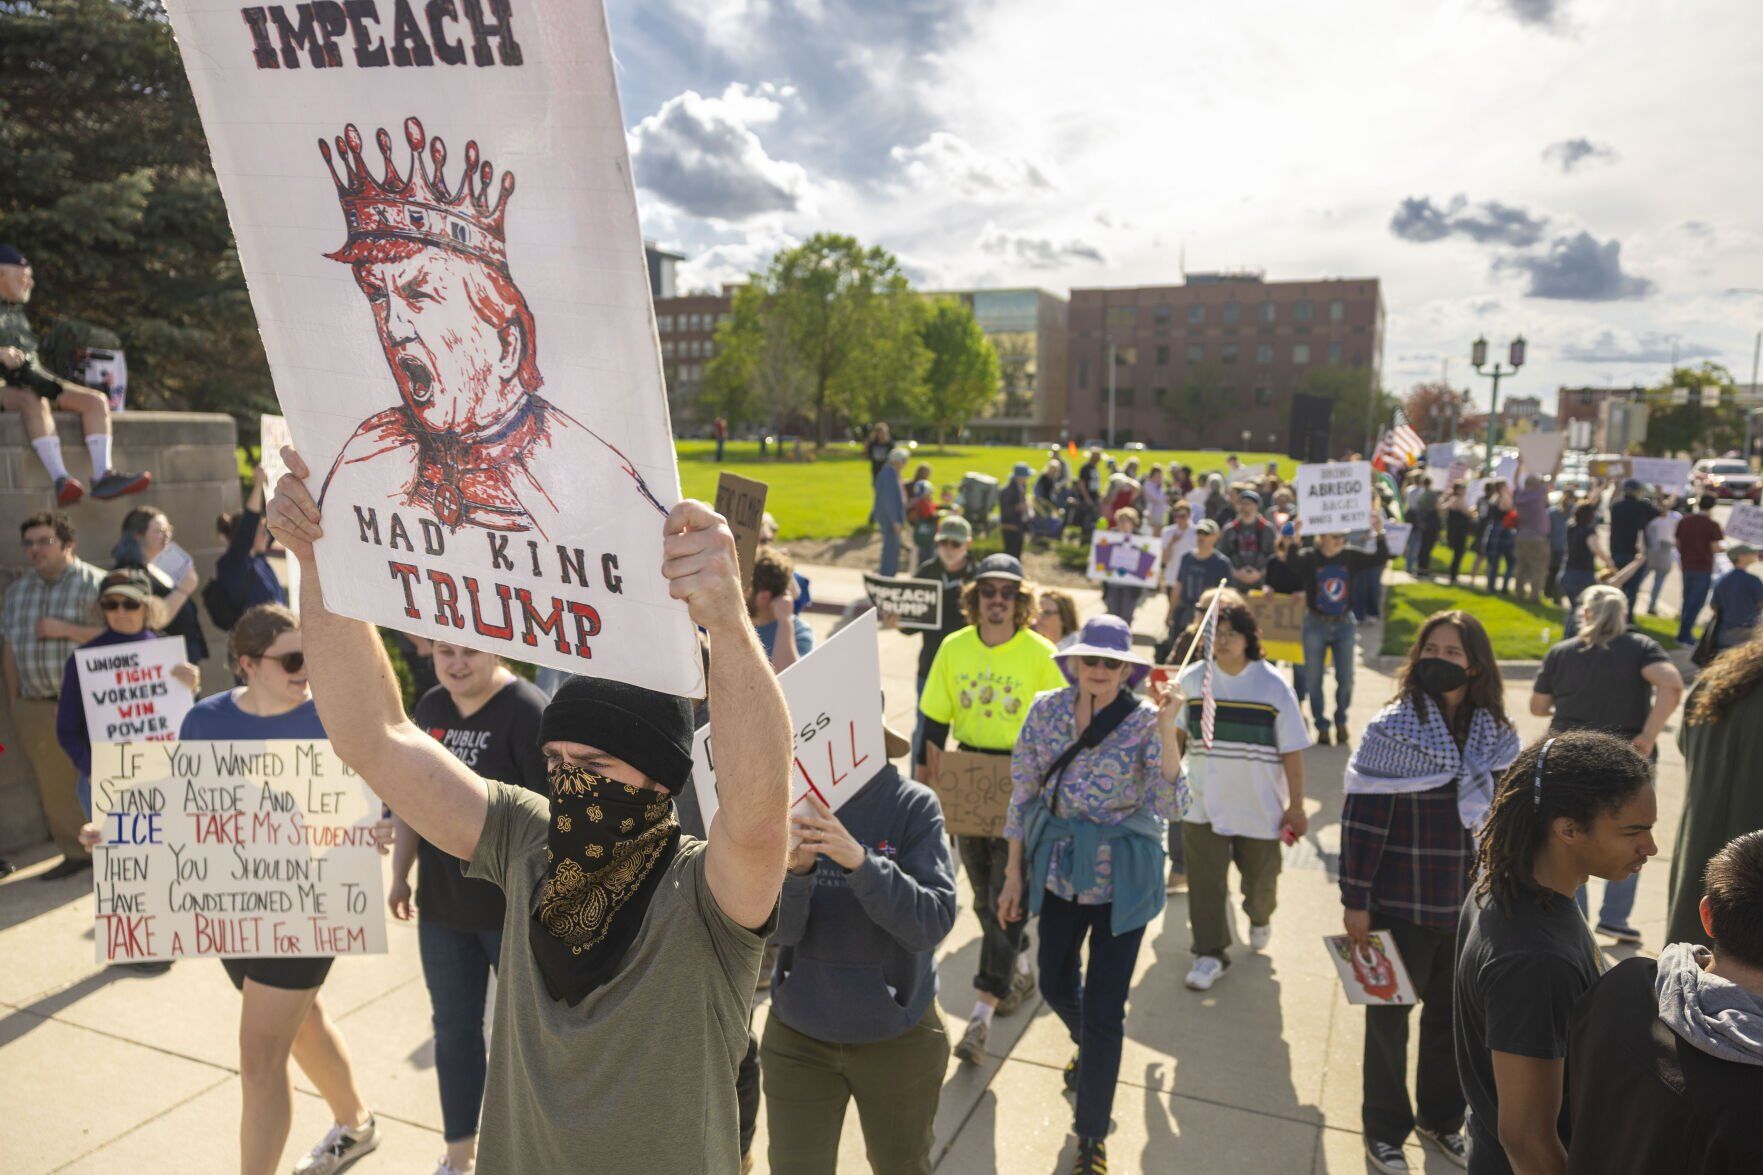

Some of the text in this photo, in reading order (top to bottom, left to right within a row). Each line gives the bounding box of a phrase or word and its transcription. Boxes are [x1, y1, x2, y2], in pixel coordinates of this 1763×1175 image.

[242, 0, 524, 69] IMPEACH
[1308, 481, 1363, 496] ABREGO
[353, 504, 623, 595] MAD KING
[388, 560, 601, 660] TRUMP
[86, 653, 139, 672] UNIONS
[115, 664, 162, 685] FIGHT
[106, 716, 168, 738] POWER
[118, 701, 154, 719] WIN
[443, 729, 491, 750] PUBLIC
[111, 741, 144, 779] IF
[163, 743, 200, 777] YOU
[211, 743, 284, 777] WANTED
[296, 743, 324, 777] ME
[95, 778, 346, 814] STAND ASIDE AND LET
[107, 812, 163, 845] ICE
[186, 812, 246, 845] TAKE
[252, 812, 281, 846] MY
[95, 845, 149, 883] THEN
[168, 843, 208, 882] YOU
[96, 880, 367, 914] HAVE CONDITIONED ME TO
[95, 913, 366, 960] TAKE A BULLET FOR THEM
